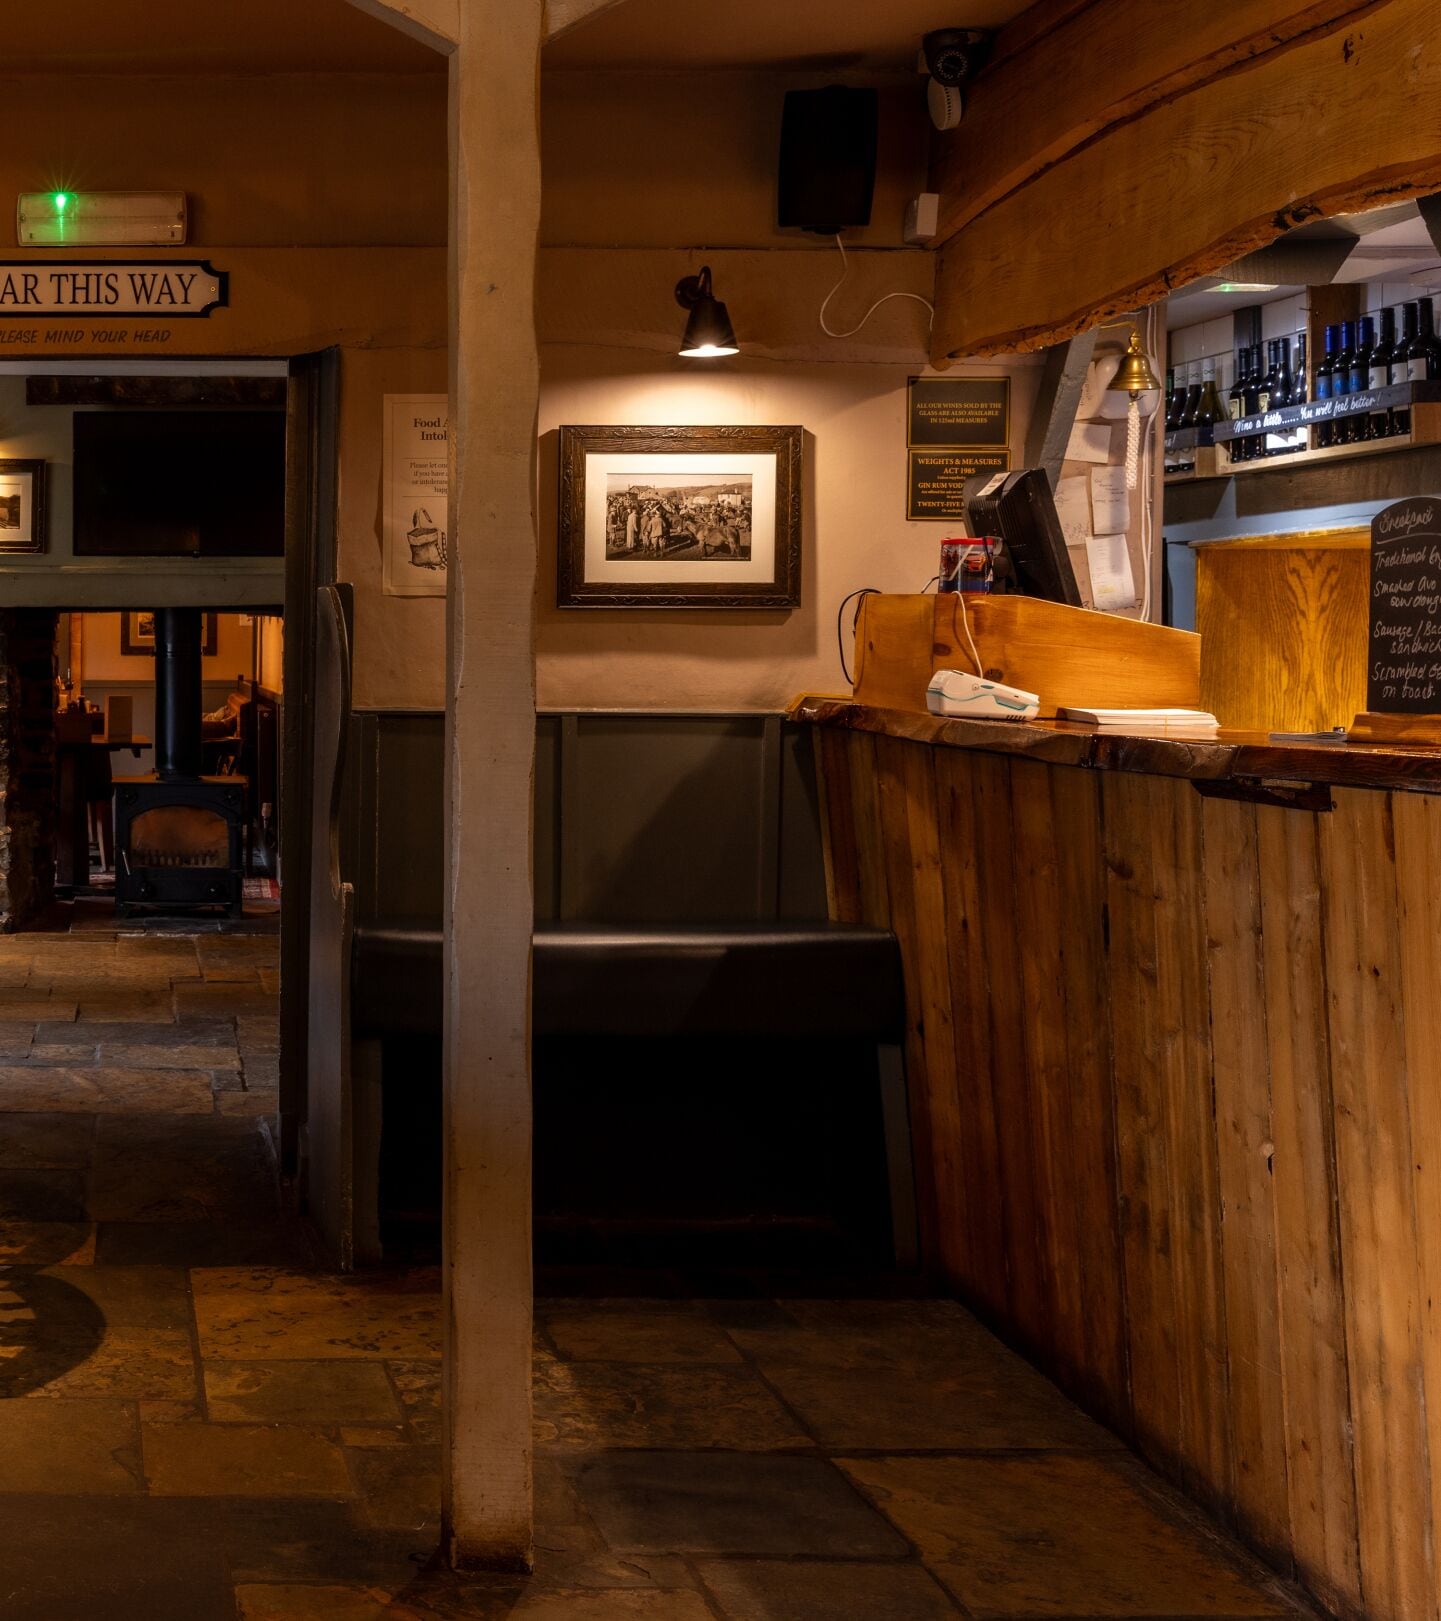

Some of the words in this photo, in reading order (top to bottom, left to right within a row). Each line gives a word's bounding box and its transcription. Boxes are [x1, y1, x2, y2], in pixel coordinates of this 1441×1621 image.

[50, 273, 119, 305] THIS
[127, 273, 198, 305] WAY
[44, 329, 84, 344] MIND
[90, 329, 127, 344] YOUR
[133, 329, 171, 343] HEAD
[413, 417, 441, 428] Food
[421, 430, 448, 441] Intol
[1373, 620, 1413, 641] Sausage
[1371, 661, 1427, 681] Scrambled
[1382, 685, 1397, 698] on
